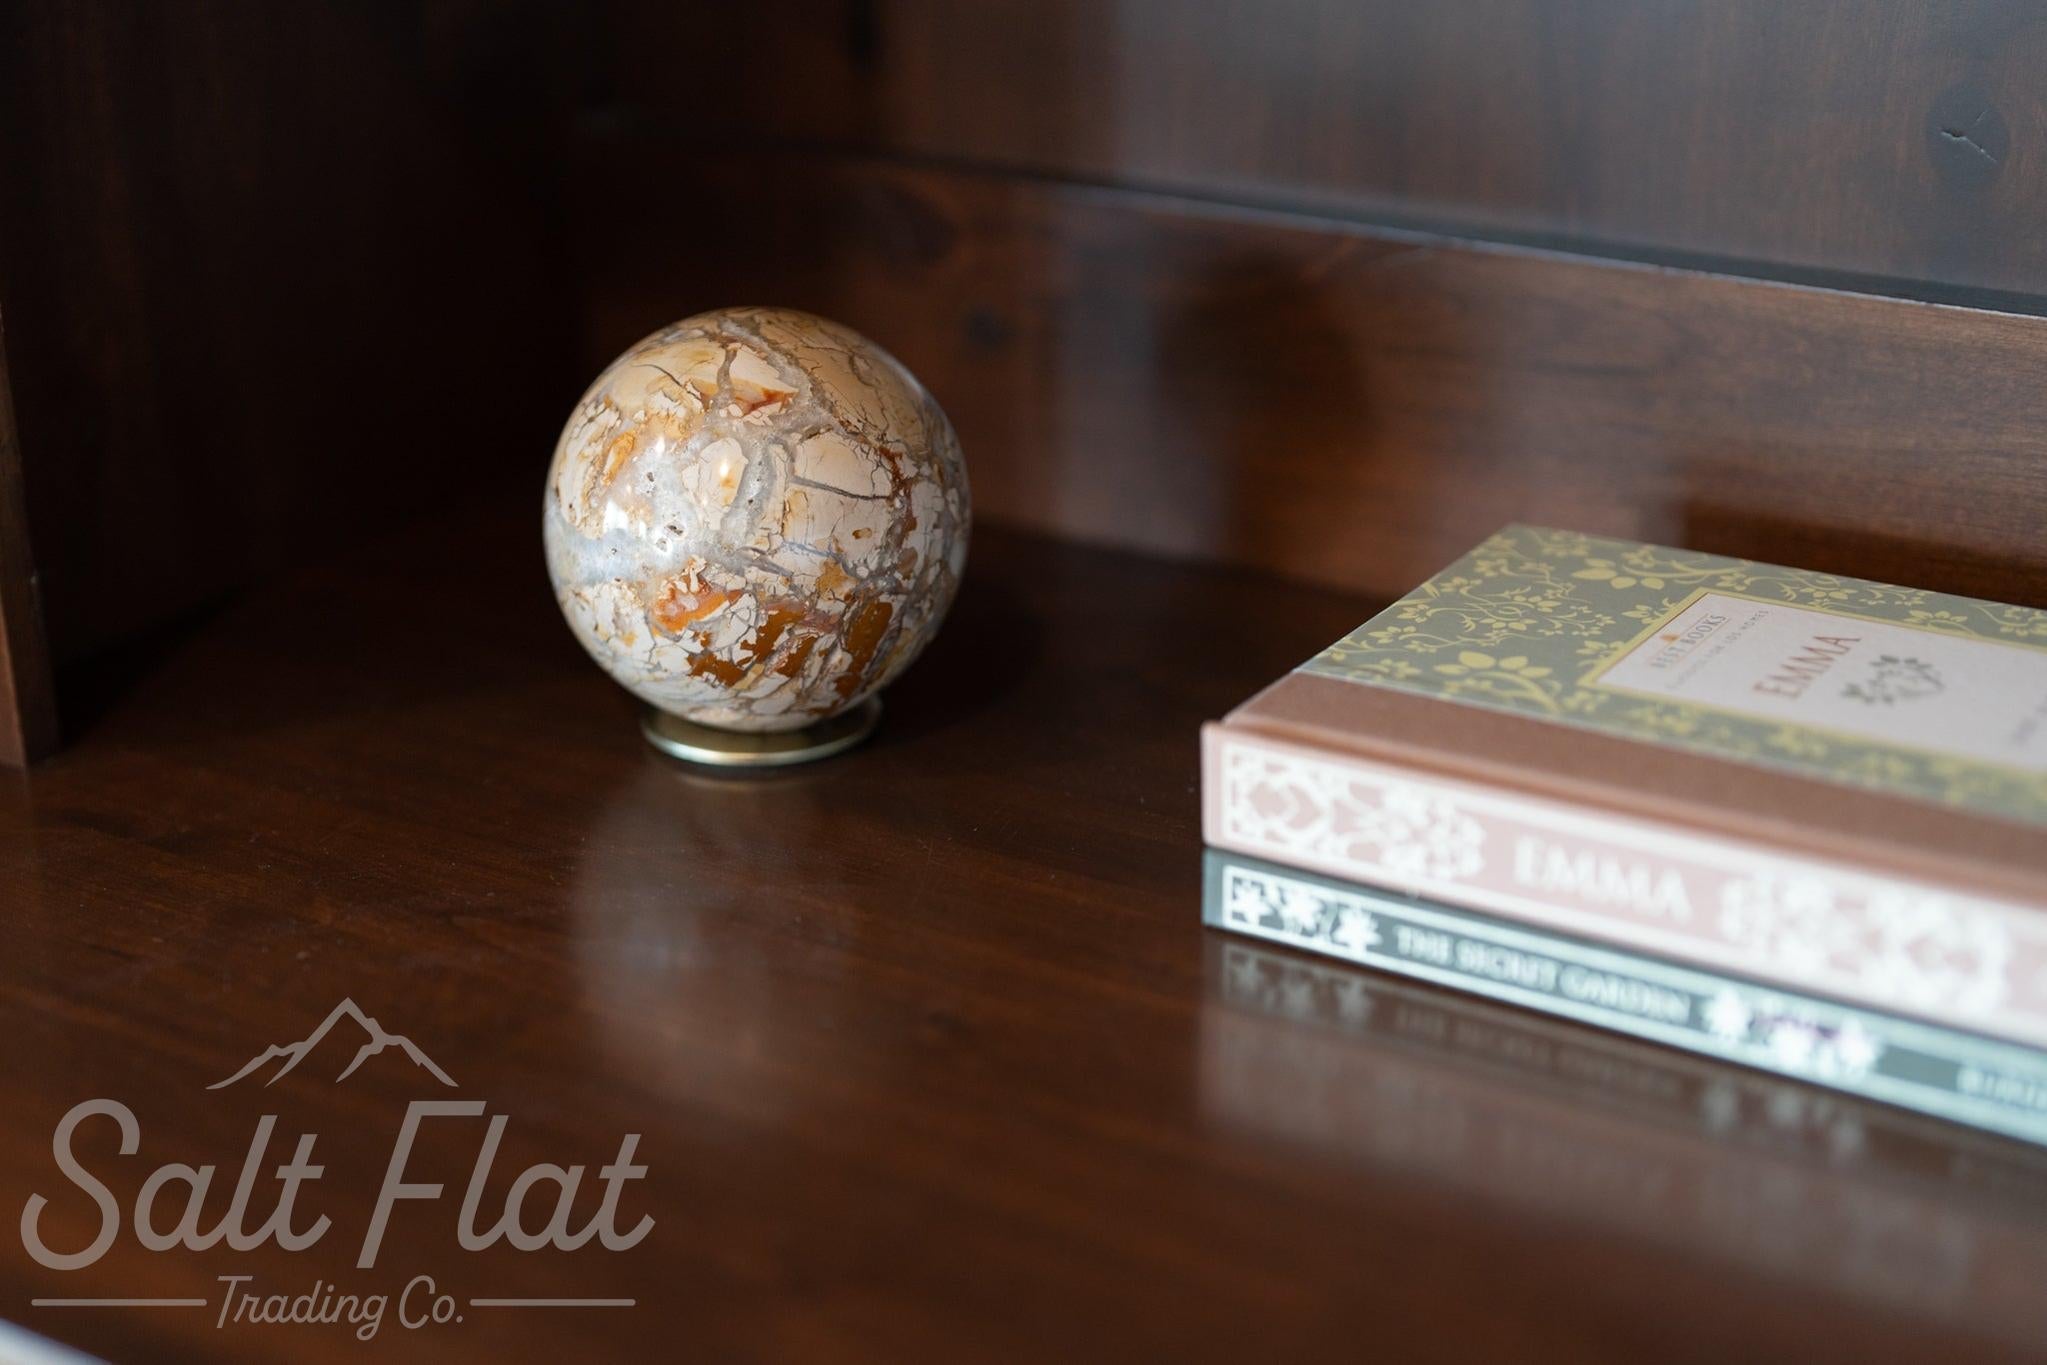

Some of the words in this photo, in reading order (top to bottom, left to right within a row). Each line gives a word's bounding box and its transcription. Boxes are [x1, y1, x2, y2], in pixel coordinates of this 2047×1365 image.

[1680, 614, 1726, 645] BOOKS
[1753, 635, 1861, 699] EMMA
[1513, 836, 1692, 923] EMMA
[1393, 923, 1453, 965] THE
[1455, 938, 1557, 991] SECRET
[1559, 964, 1692, 1027] GARDEN
